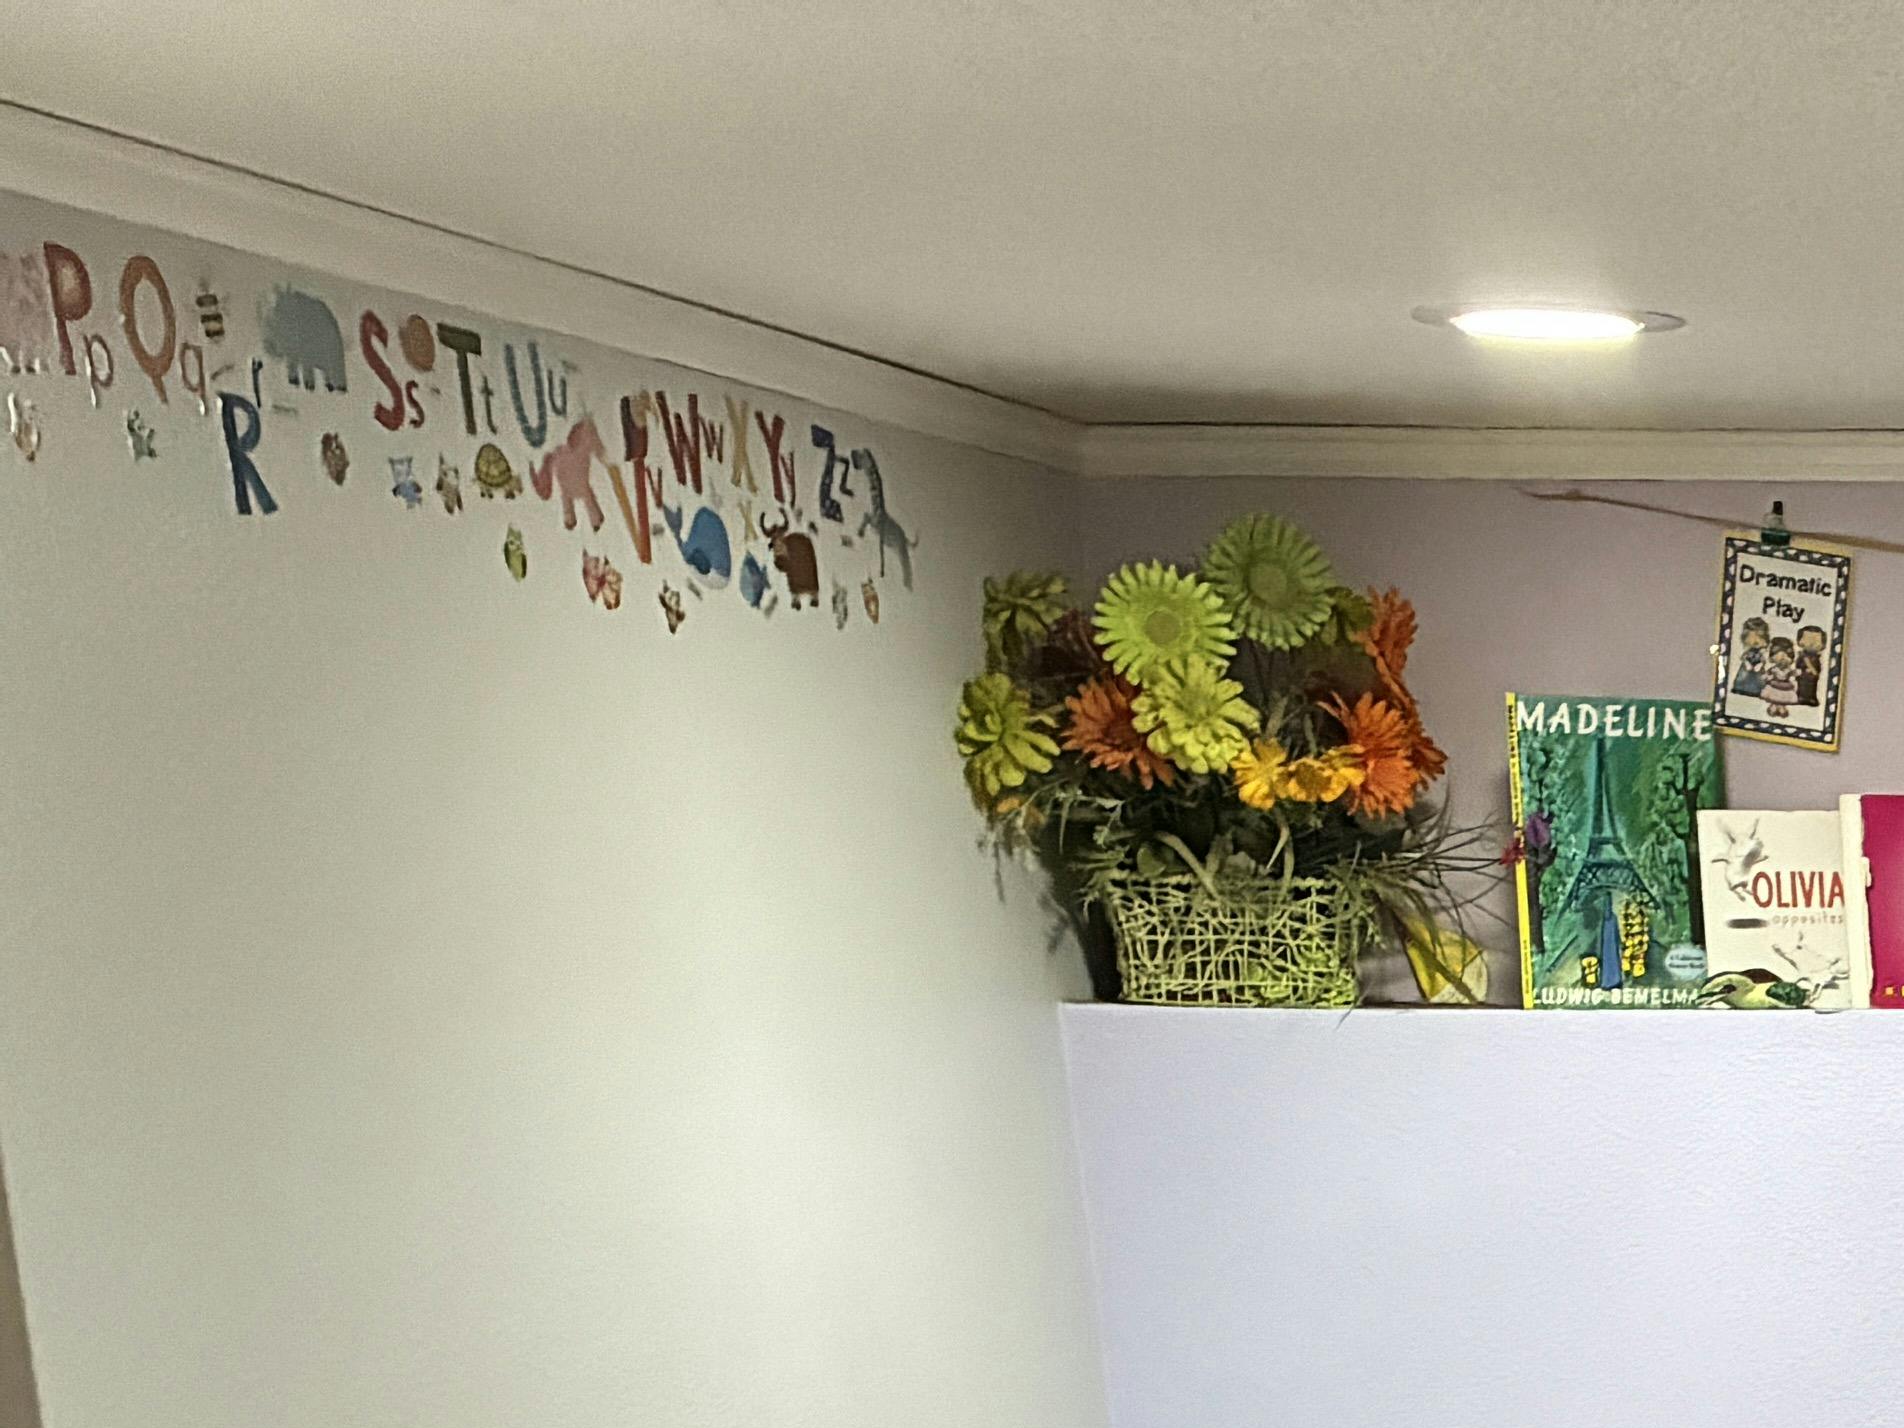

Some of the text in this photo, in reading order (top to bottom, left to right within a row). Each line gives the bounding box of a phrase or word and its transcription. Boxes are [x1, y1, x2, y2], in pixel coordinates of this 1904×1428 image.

[1740, 564, 1832, 597] Dramatic
[1762, 596, 1805, 623] Play
[1517, 701, 1713, 741] MADELINE
[1752, 871, 1845, 908] OLIVIA
[1532, 987, 1603, 1005] LUDWIG
